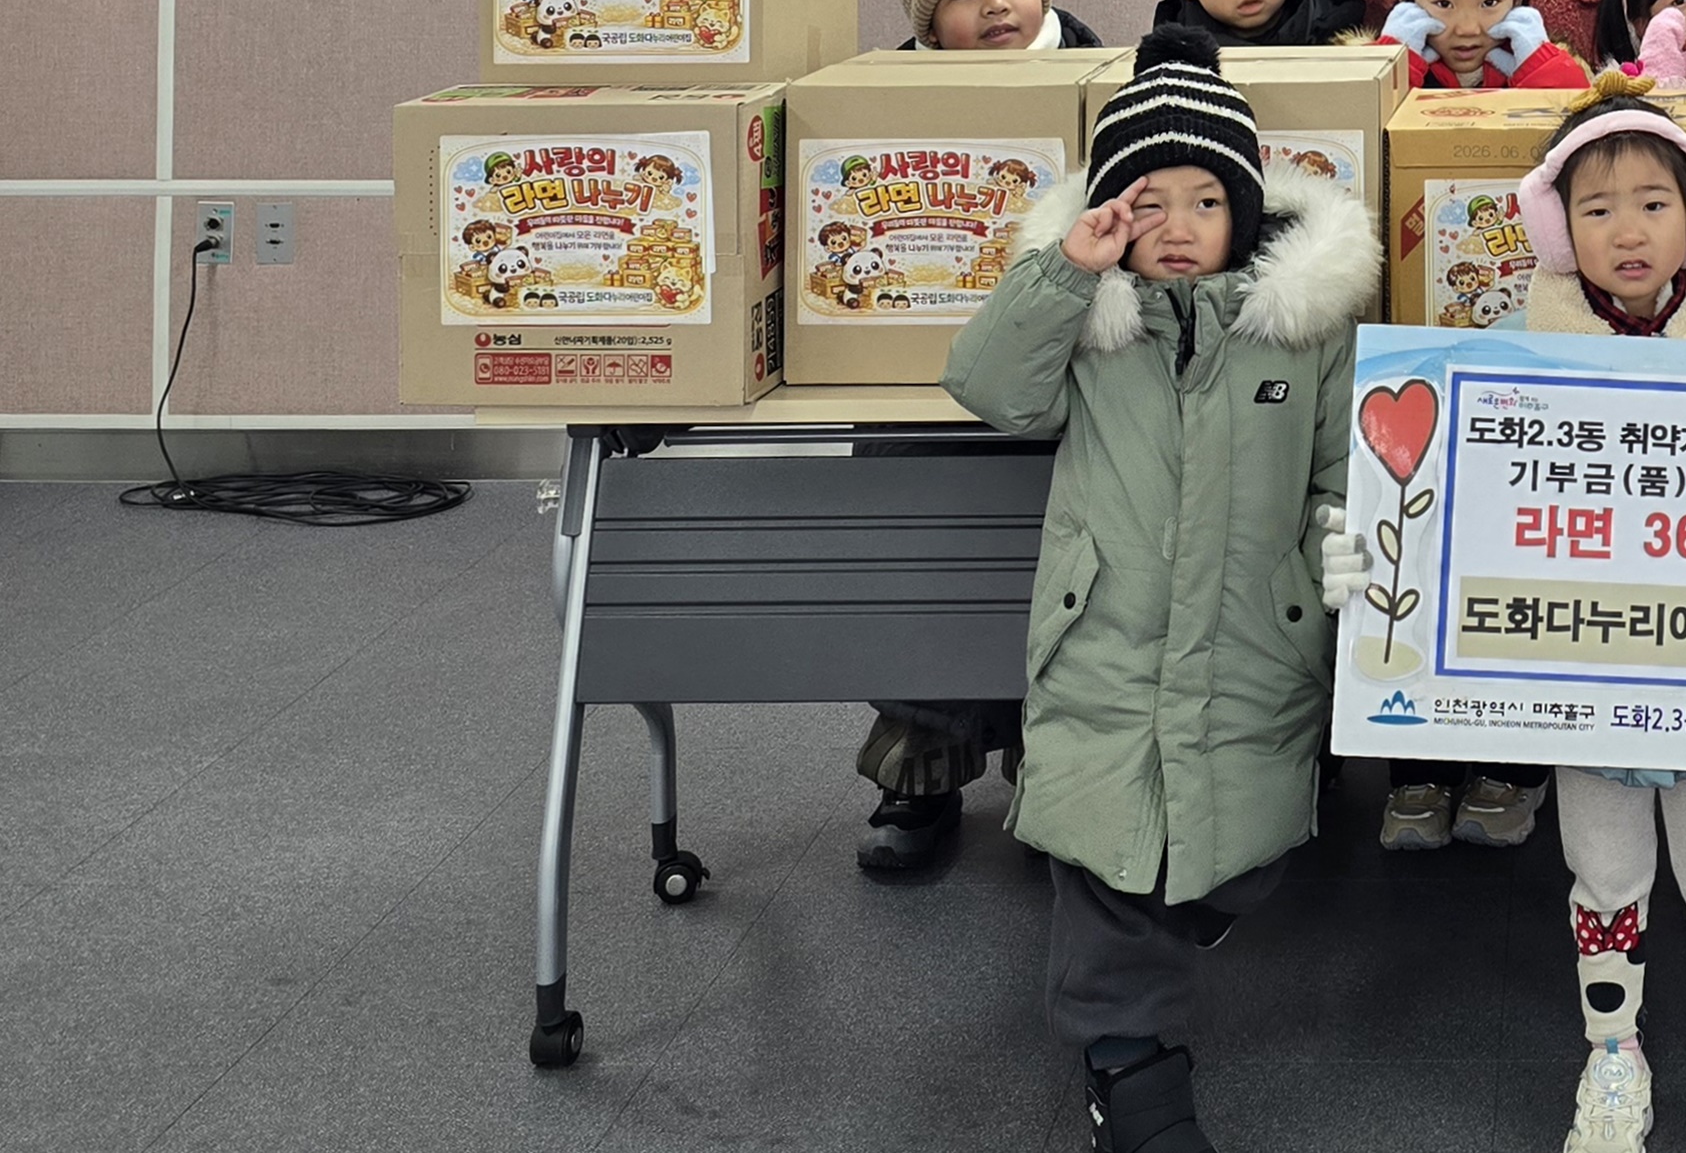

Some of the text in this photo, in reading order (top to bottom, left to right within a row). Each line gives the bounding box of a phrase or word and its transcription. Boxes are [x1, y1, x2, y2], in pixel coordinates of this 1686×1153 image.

[522, 147, 616, 176] 사랑의
[877, 151, 970, 180] 사랑의
[500, 178, 655, 213] 라면 나누기
[856, 181, 1008, 216] 라면 나누기
[558, 291, 585, 303] 국공립
[493, 333, 522, 346] 농심
[493, 365, 549, 375] 080-023-5181
[1466, 416, 1606, 452] 도화2.3동
[1515, 504, 1613, 559] 라면
[1433, 698, 1595, 721] 인천광역시 미추홀구
[1489, 719, 1521, 729] INCHEON
[1579, 723, 1595, 732] CITY
